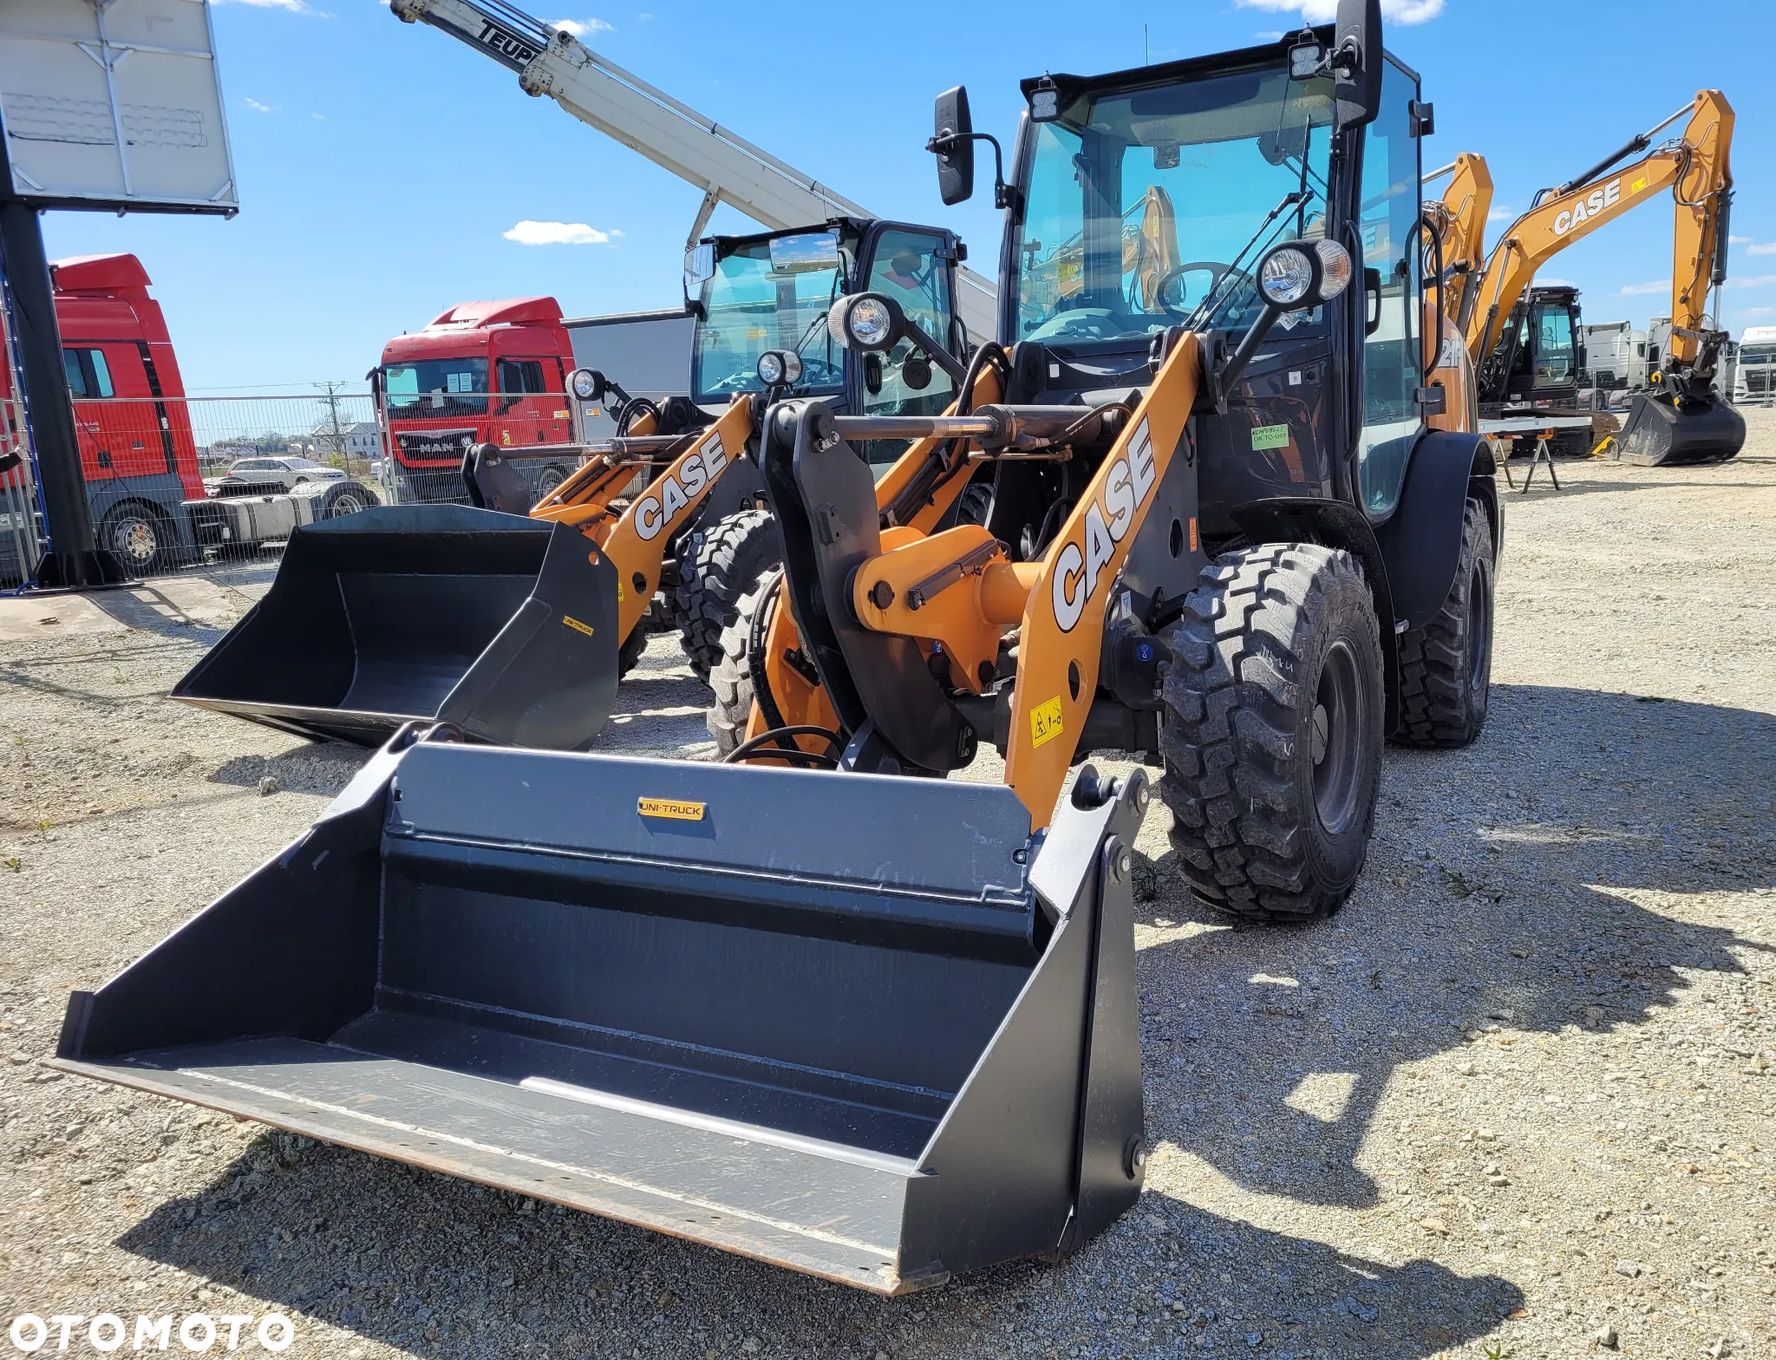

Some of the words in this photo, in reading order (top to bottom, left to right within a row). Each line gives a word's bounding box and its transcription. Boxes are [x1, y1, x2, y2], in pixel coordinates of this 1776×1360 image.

[1554, 177, 1621, 236] CASE
[420, 443, 453, 452] MAN
[634, 429, 729, 541] CASE
[1051, 411, 1156, 634] CASE
[640, 803, 700, 815] UNI-TRUCK
